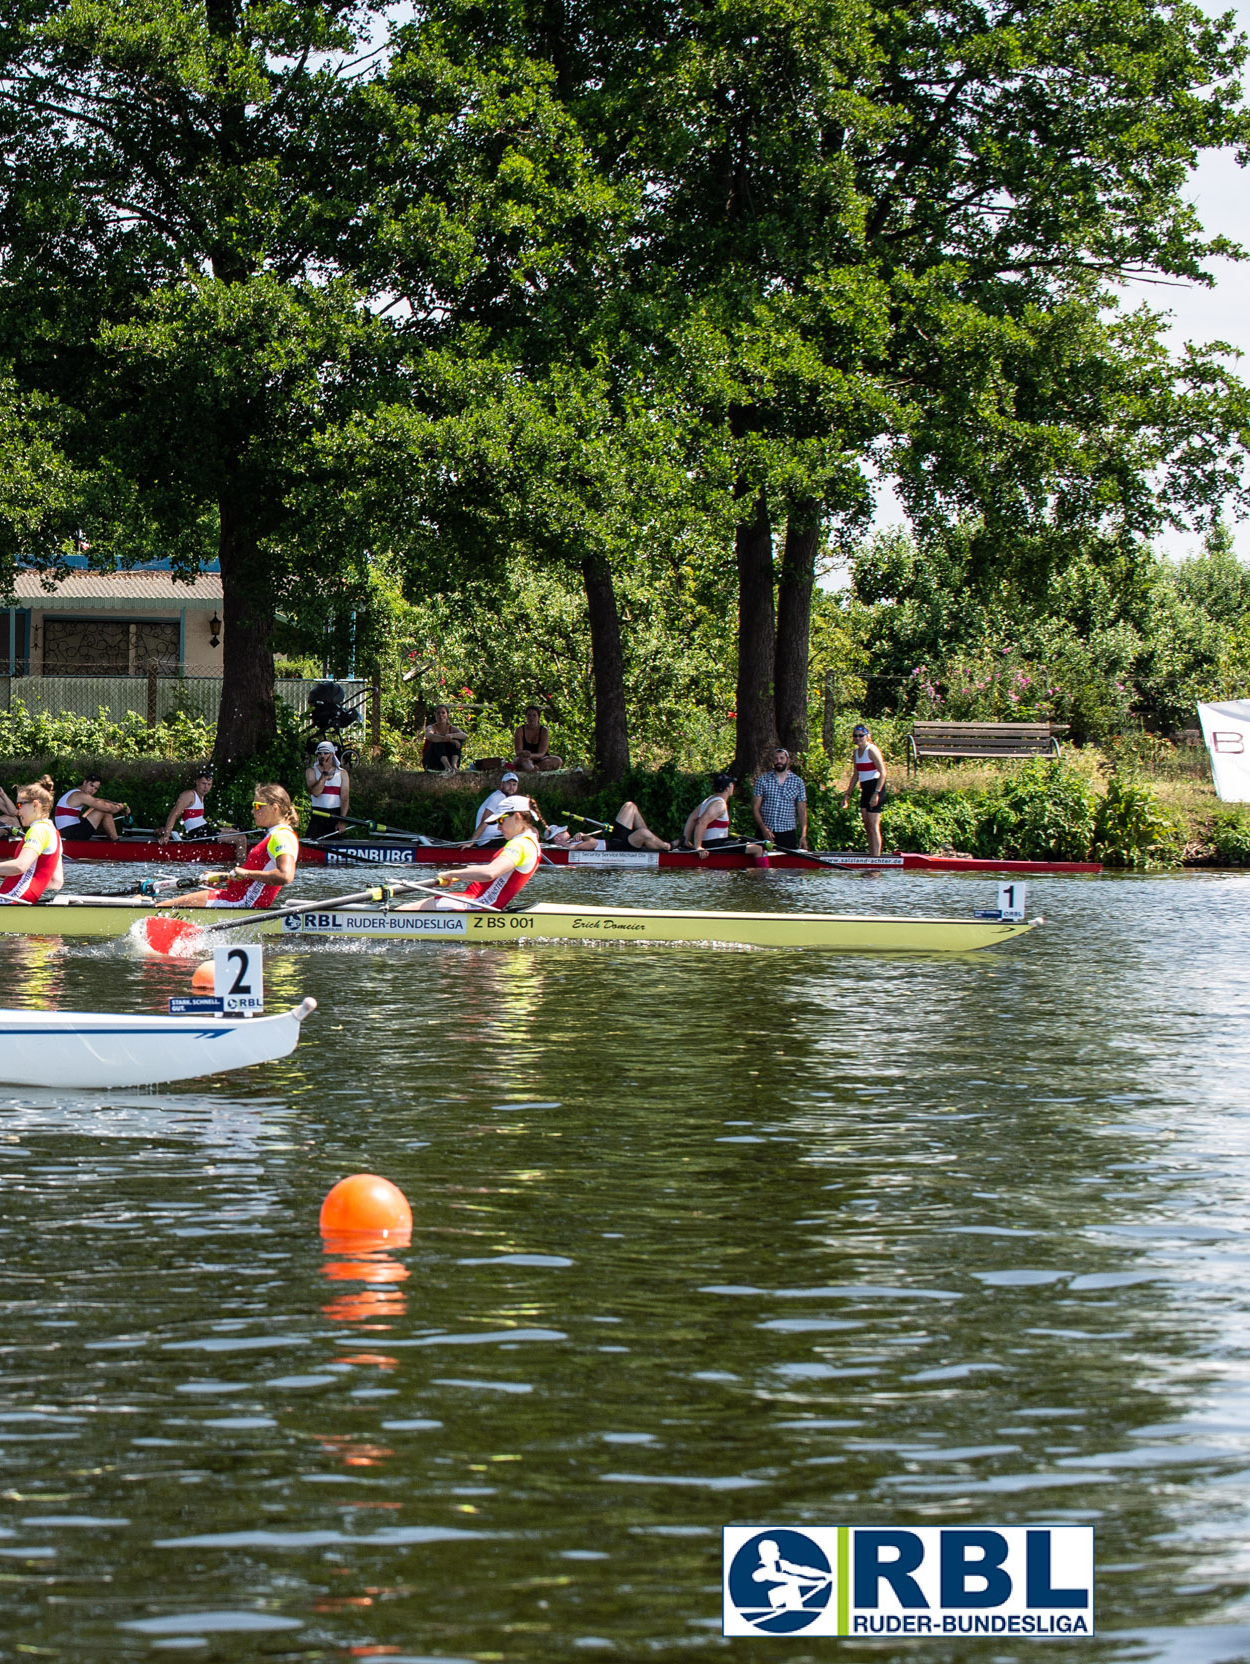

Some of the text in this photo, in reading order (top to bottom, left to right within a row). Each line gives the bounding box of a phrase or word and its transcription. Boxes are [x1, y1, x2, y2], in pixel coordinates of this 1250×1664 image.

[1002, 885, 1015, 908] 1
[304, 914, 464, 930] RBL RUDER-BUNDESLIGA
[473, 917, 534, 929] Z BS 001
[572, 918, 646, 931] Erich Domeier
[227, 949, 252, 995] 2
[239, 998, 263, 1007] RBL
